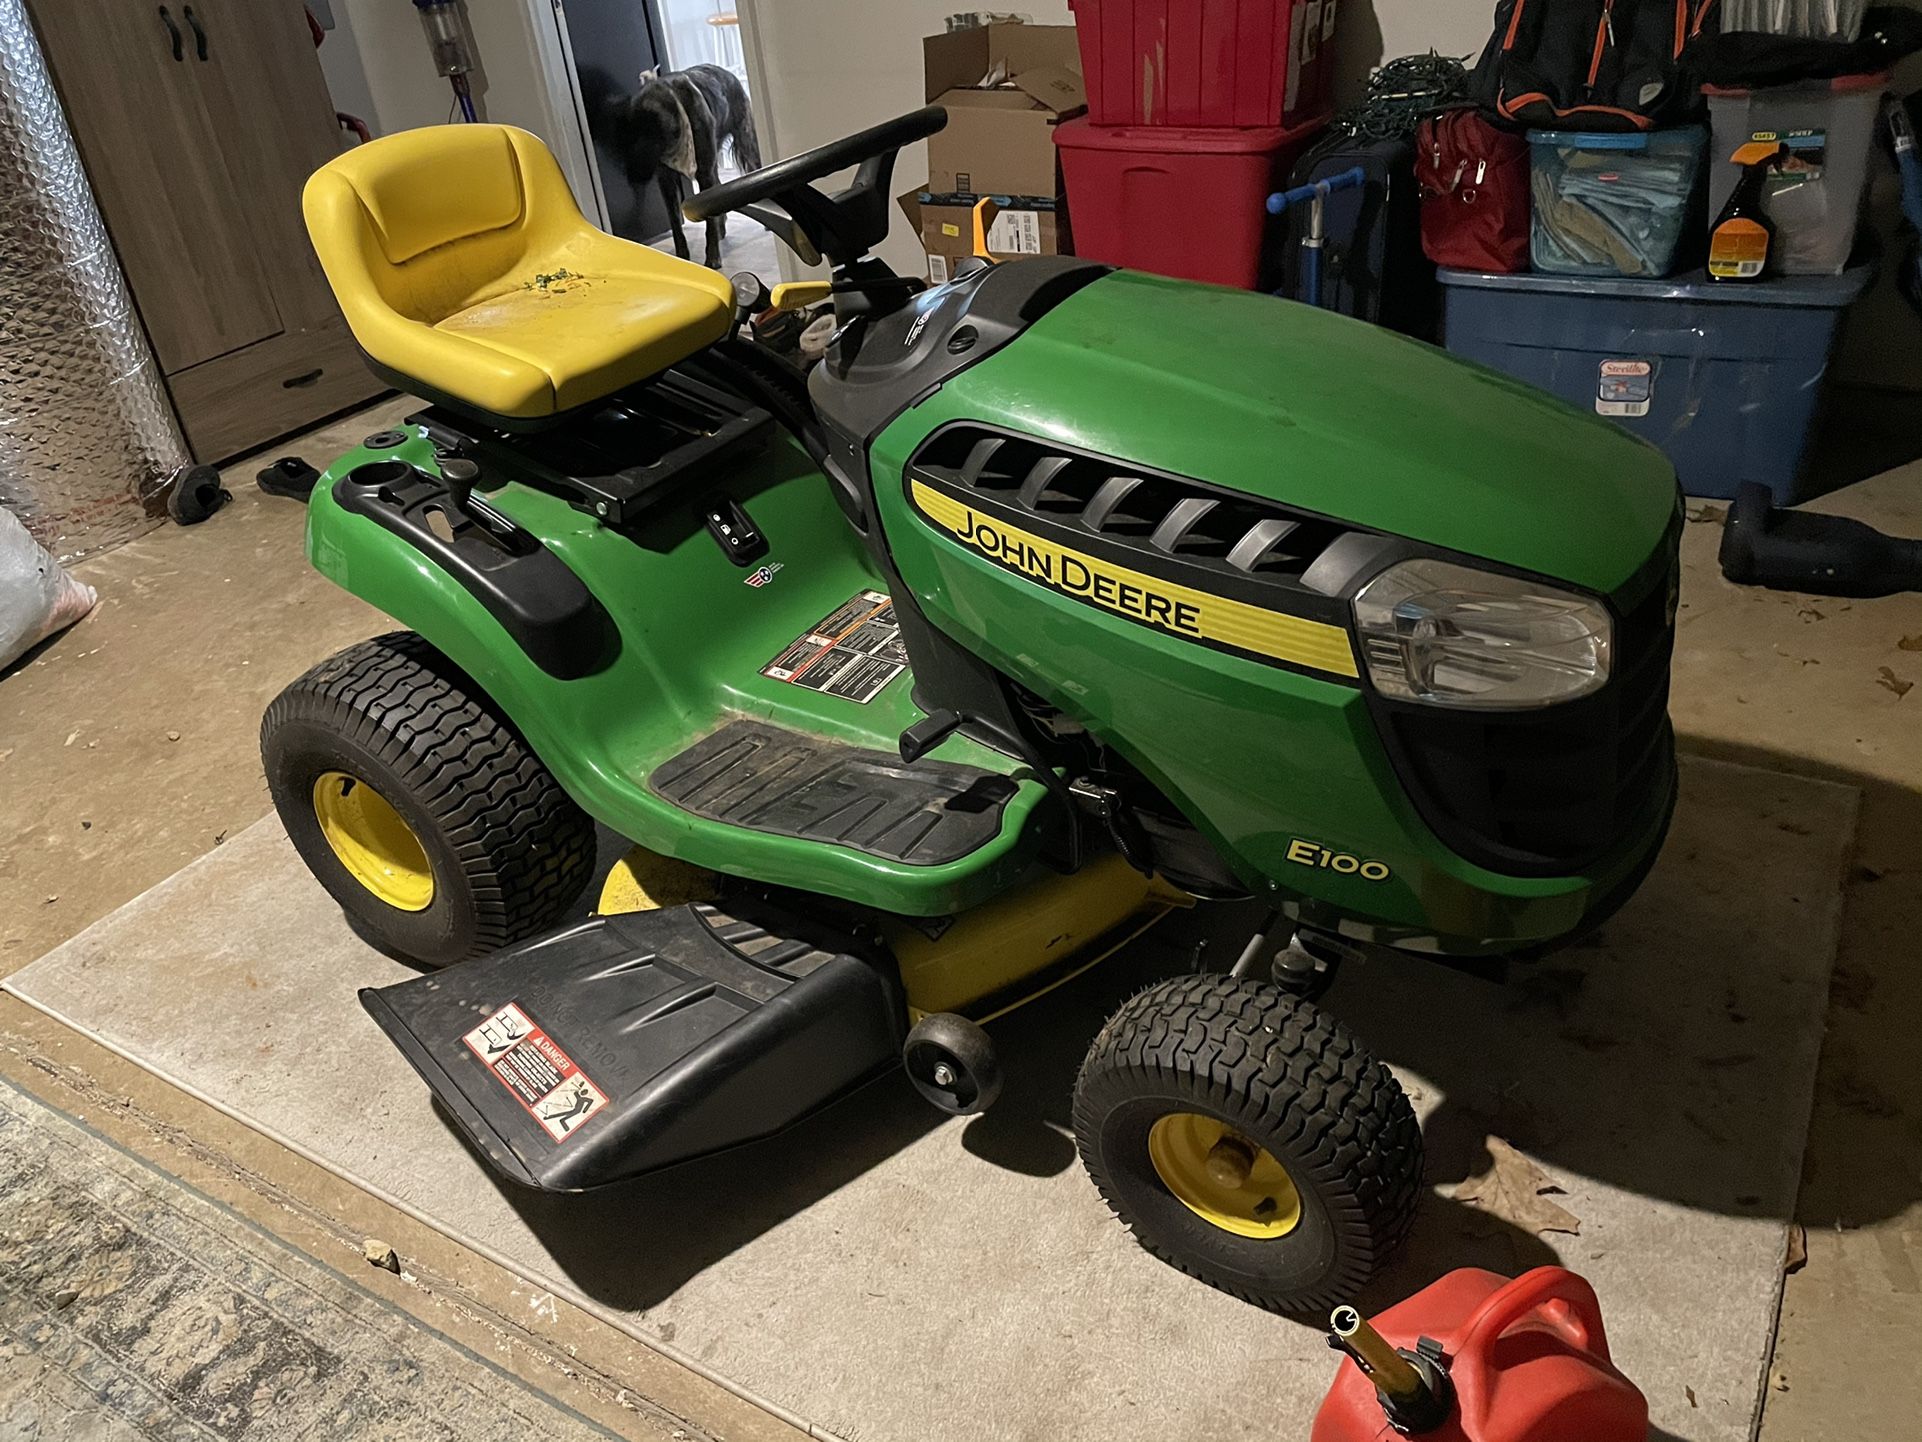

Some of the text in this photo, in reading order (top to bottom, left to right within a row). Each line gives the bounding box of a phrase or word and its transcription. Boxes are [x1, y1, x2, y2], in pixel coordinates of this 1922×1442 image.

[957, 510, 1200, 634] JOHN DEERE
[1286, 839, 1390, 880] E100
[540, 1041, 571, 1071] DANGER
